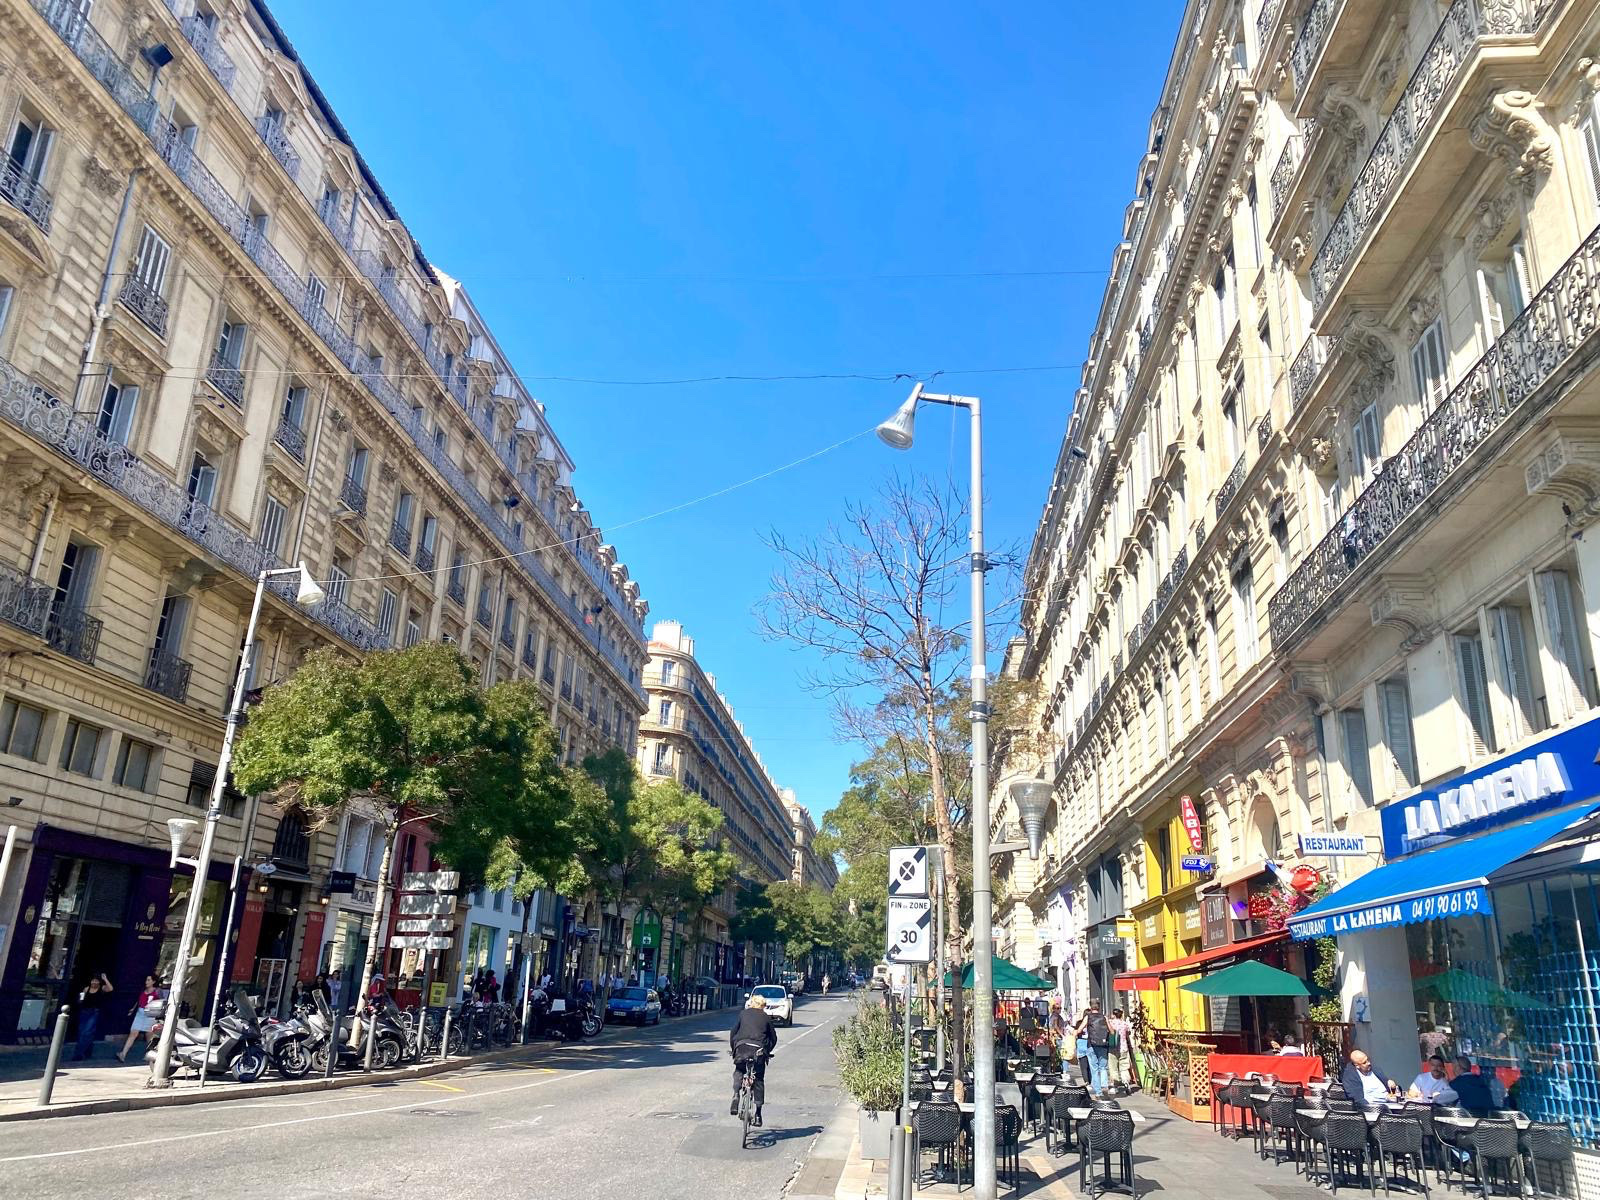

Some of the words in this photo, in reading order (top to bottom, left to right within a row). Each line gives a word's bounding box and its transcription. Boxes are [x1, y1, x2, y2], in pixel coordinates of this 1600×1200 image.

[1404, 799, 1441, 840] LA
[1438, 752, 1570, 829] KAHENA
[1183, 798, 1202, 848] TABAC
[1304, 837, 1364, 851] RESTAURANT
[1333, 915, 1348, 931] LA
[1412, 901, 1423, 918] 04
[1425, 897, 1435, 916] 91
[1437, 895, 1449, 914] 90
[1450, 892, 1461, 912] 61
[1465, 890, 1478, 911] 93
[900, 929, 918, 944] 30
